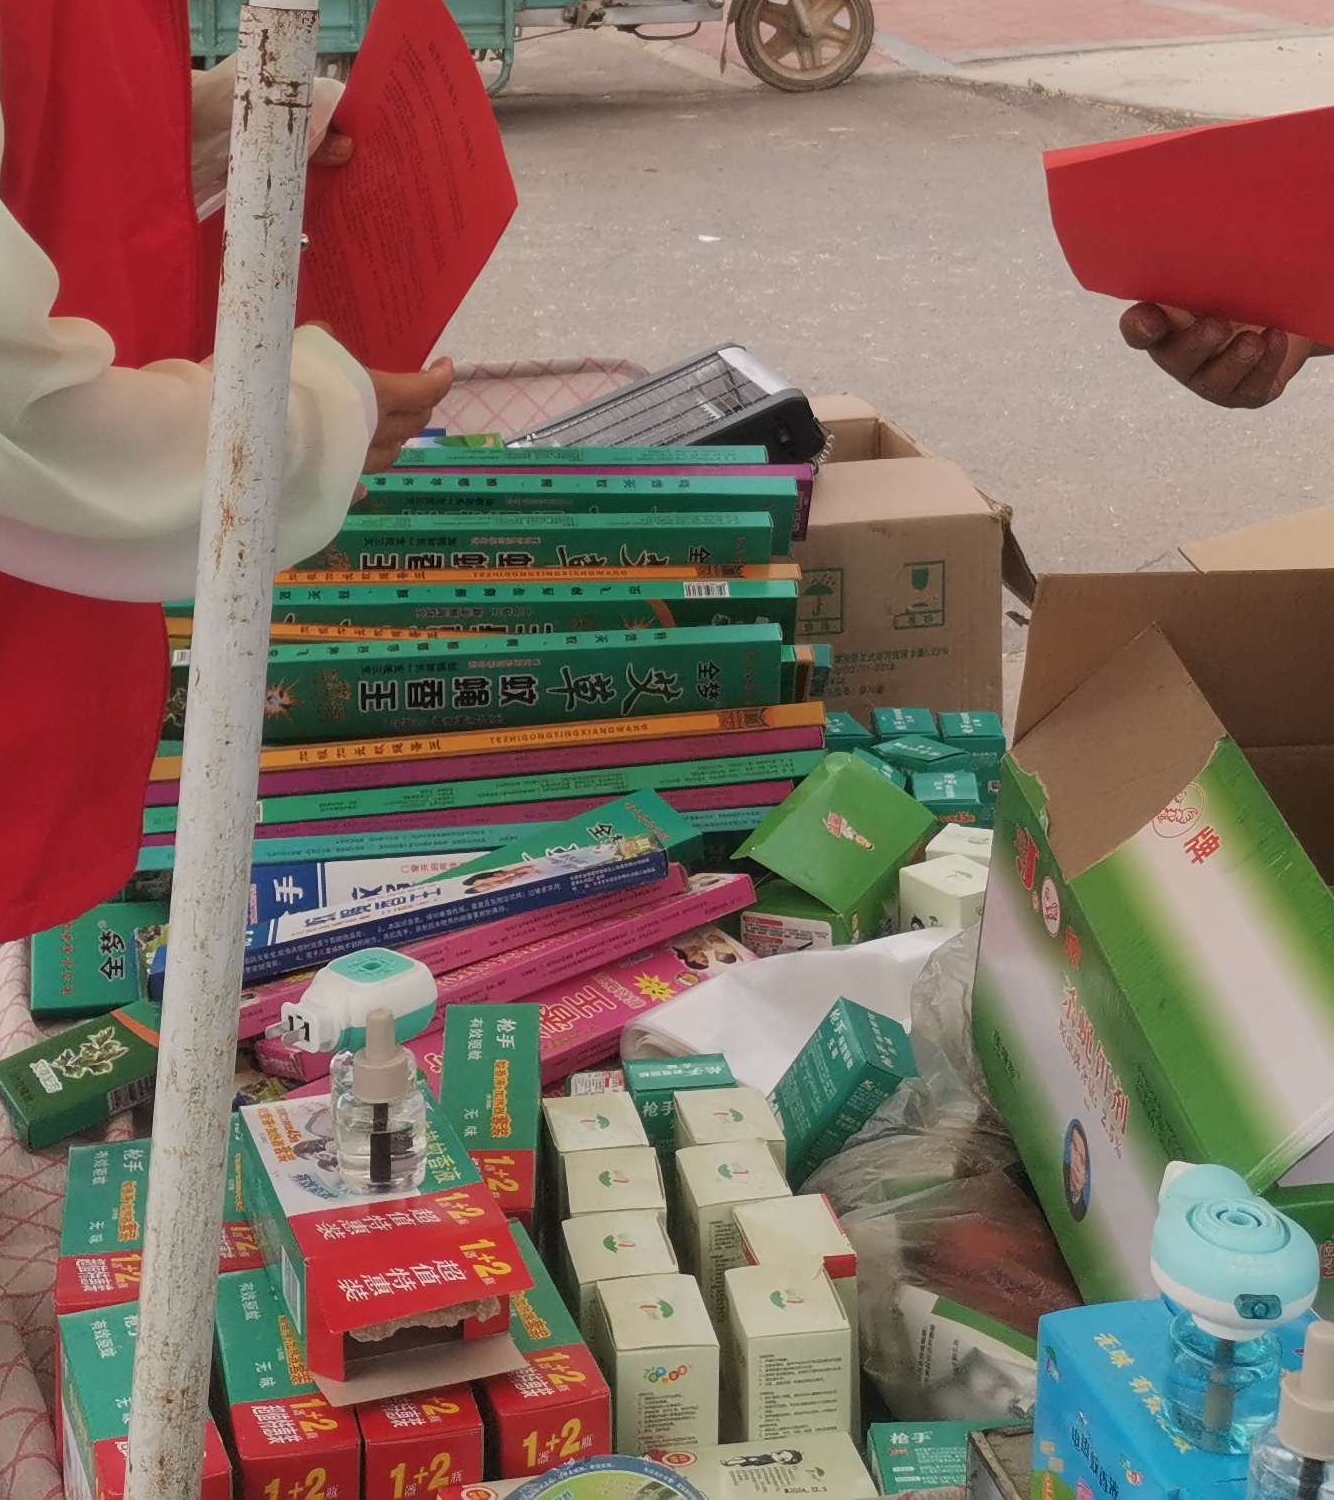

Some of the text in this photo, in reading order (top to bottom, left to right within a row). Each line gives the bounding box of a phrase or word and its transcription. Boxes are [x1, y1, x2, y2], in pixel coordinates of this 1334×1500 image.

[489, 721, 650, 746] TEZHIGONGTINGXIANGWANG
[1183, 825, 1222, 865] 牌
[98, 928, 126, 982] 全梦
[496, 1018, 518, 1050] 枪手
[830, 1008, 847, 1034] 枪手
[468, 1016, 484, 1061] 有效驱蚊
[463, 1107, 479, 1138] 无味
[641, 1100, 676, 1119] 枪手
[91, 1150, 109, 1186] 有效驱蚊
[123, 1148, 145, 1174] 枪手
[316, 1208, 442, 1241] 超值特惠装
[337, 1258, 466, 1303] 超值特惠装
[237, 1281, 262, 1322] 有效驱蚊
[90, 1318, 118, 1359] 有效驱蚊
[253, 1360, 279, 1390] 无味
[250, 1403, 304, 1445] 超值特惠装
[889, 1430, 934, 1445] 枪手
